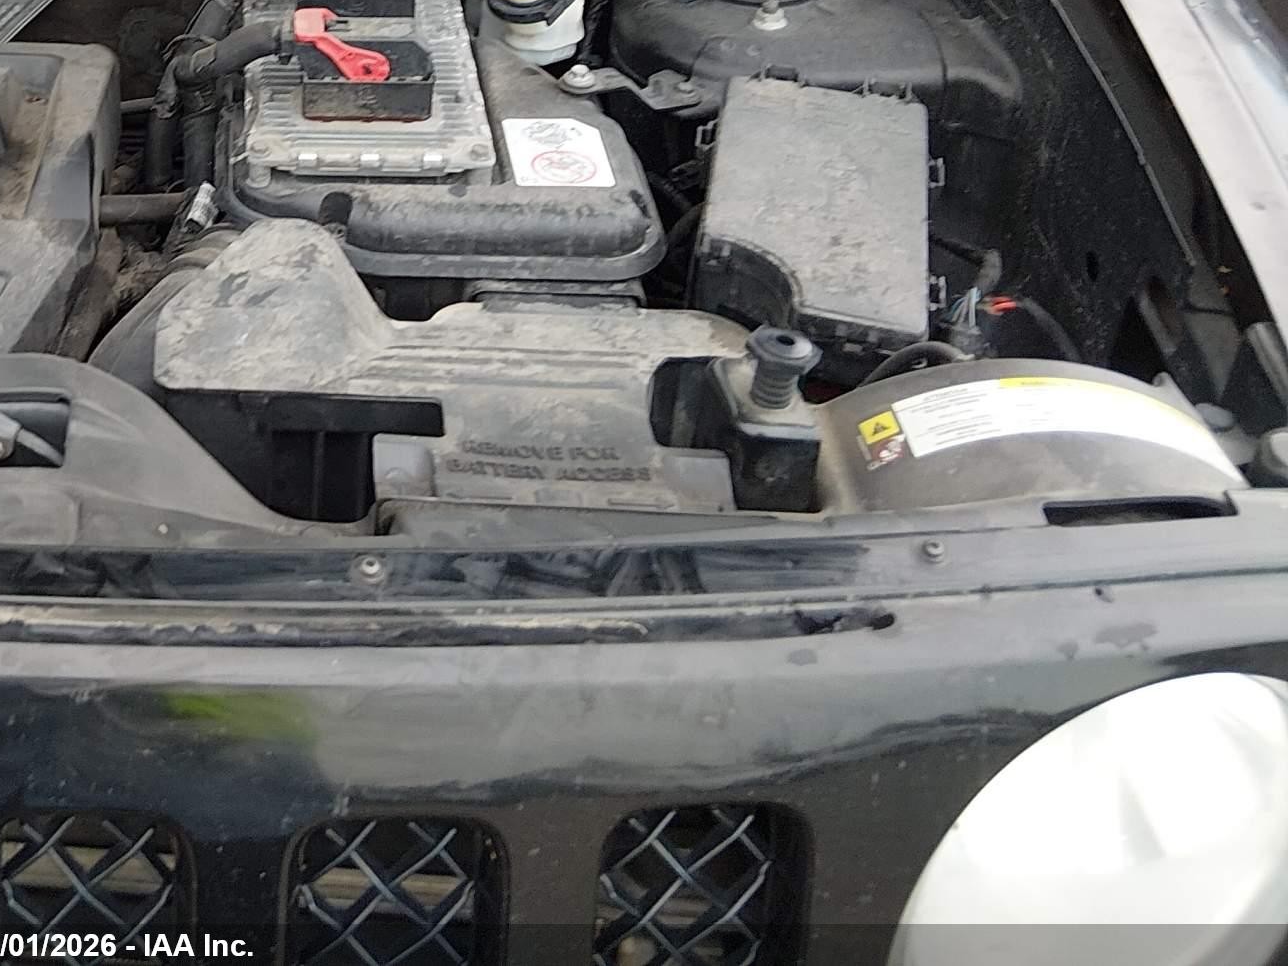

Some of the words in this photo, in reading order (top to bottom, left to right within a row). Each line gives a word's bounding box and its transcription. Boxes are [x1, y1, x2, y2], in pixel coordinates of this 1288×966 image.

[462, 439, 564, 460] REMOVE
[569, 446, 619, 461] FOR
[446, 458, 546, 480] BATTERY
[555, 465, 651, 481] ACCESS
